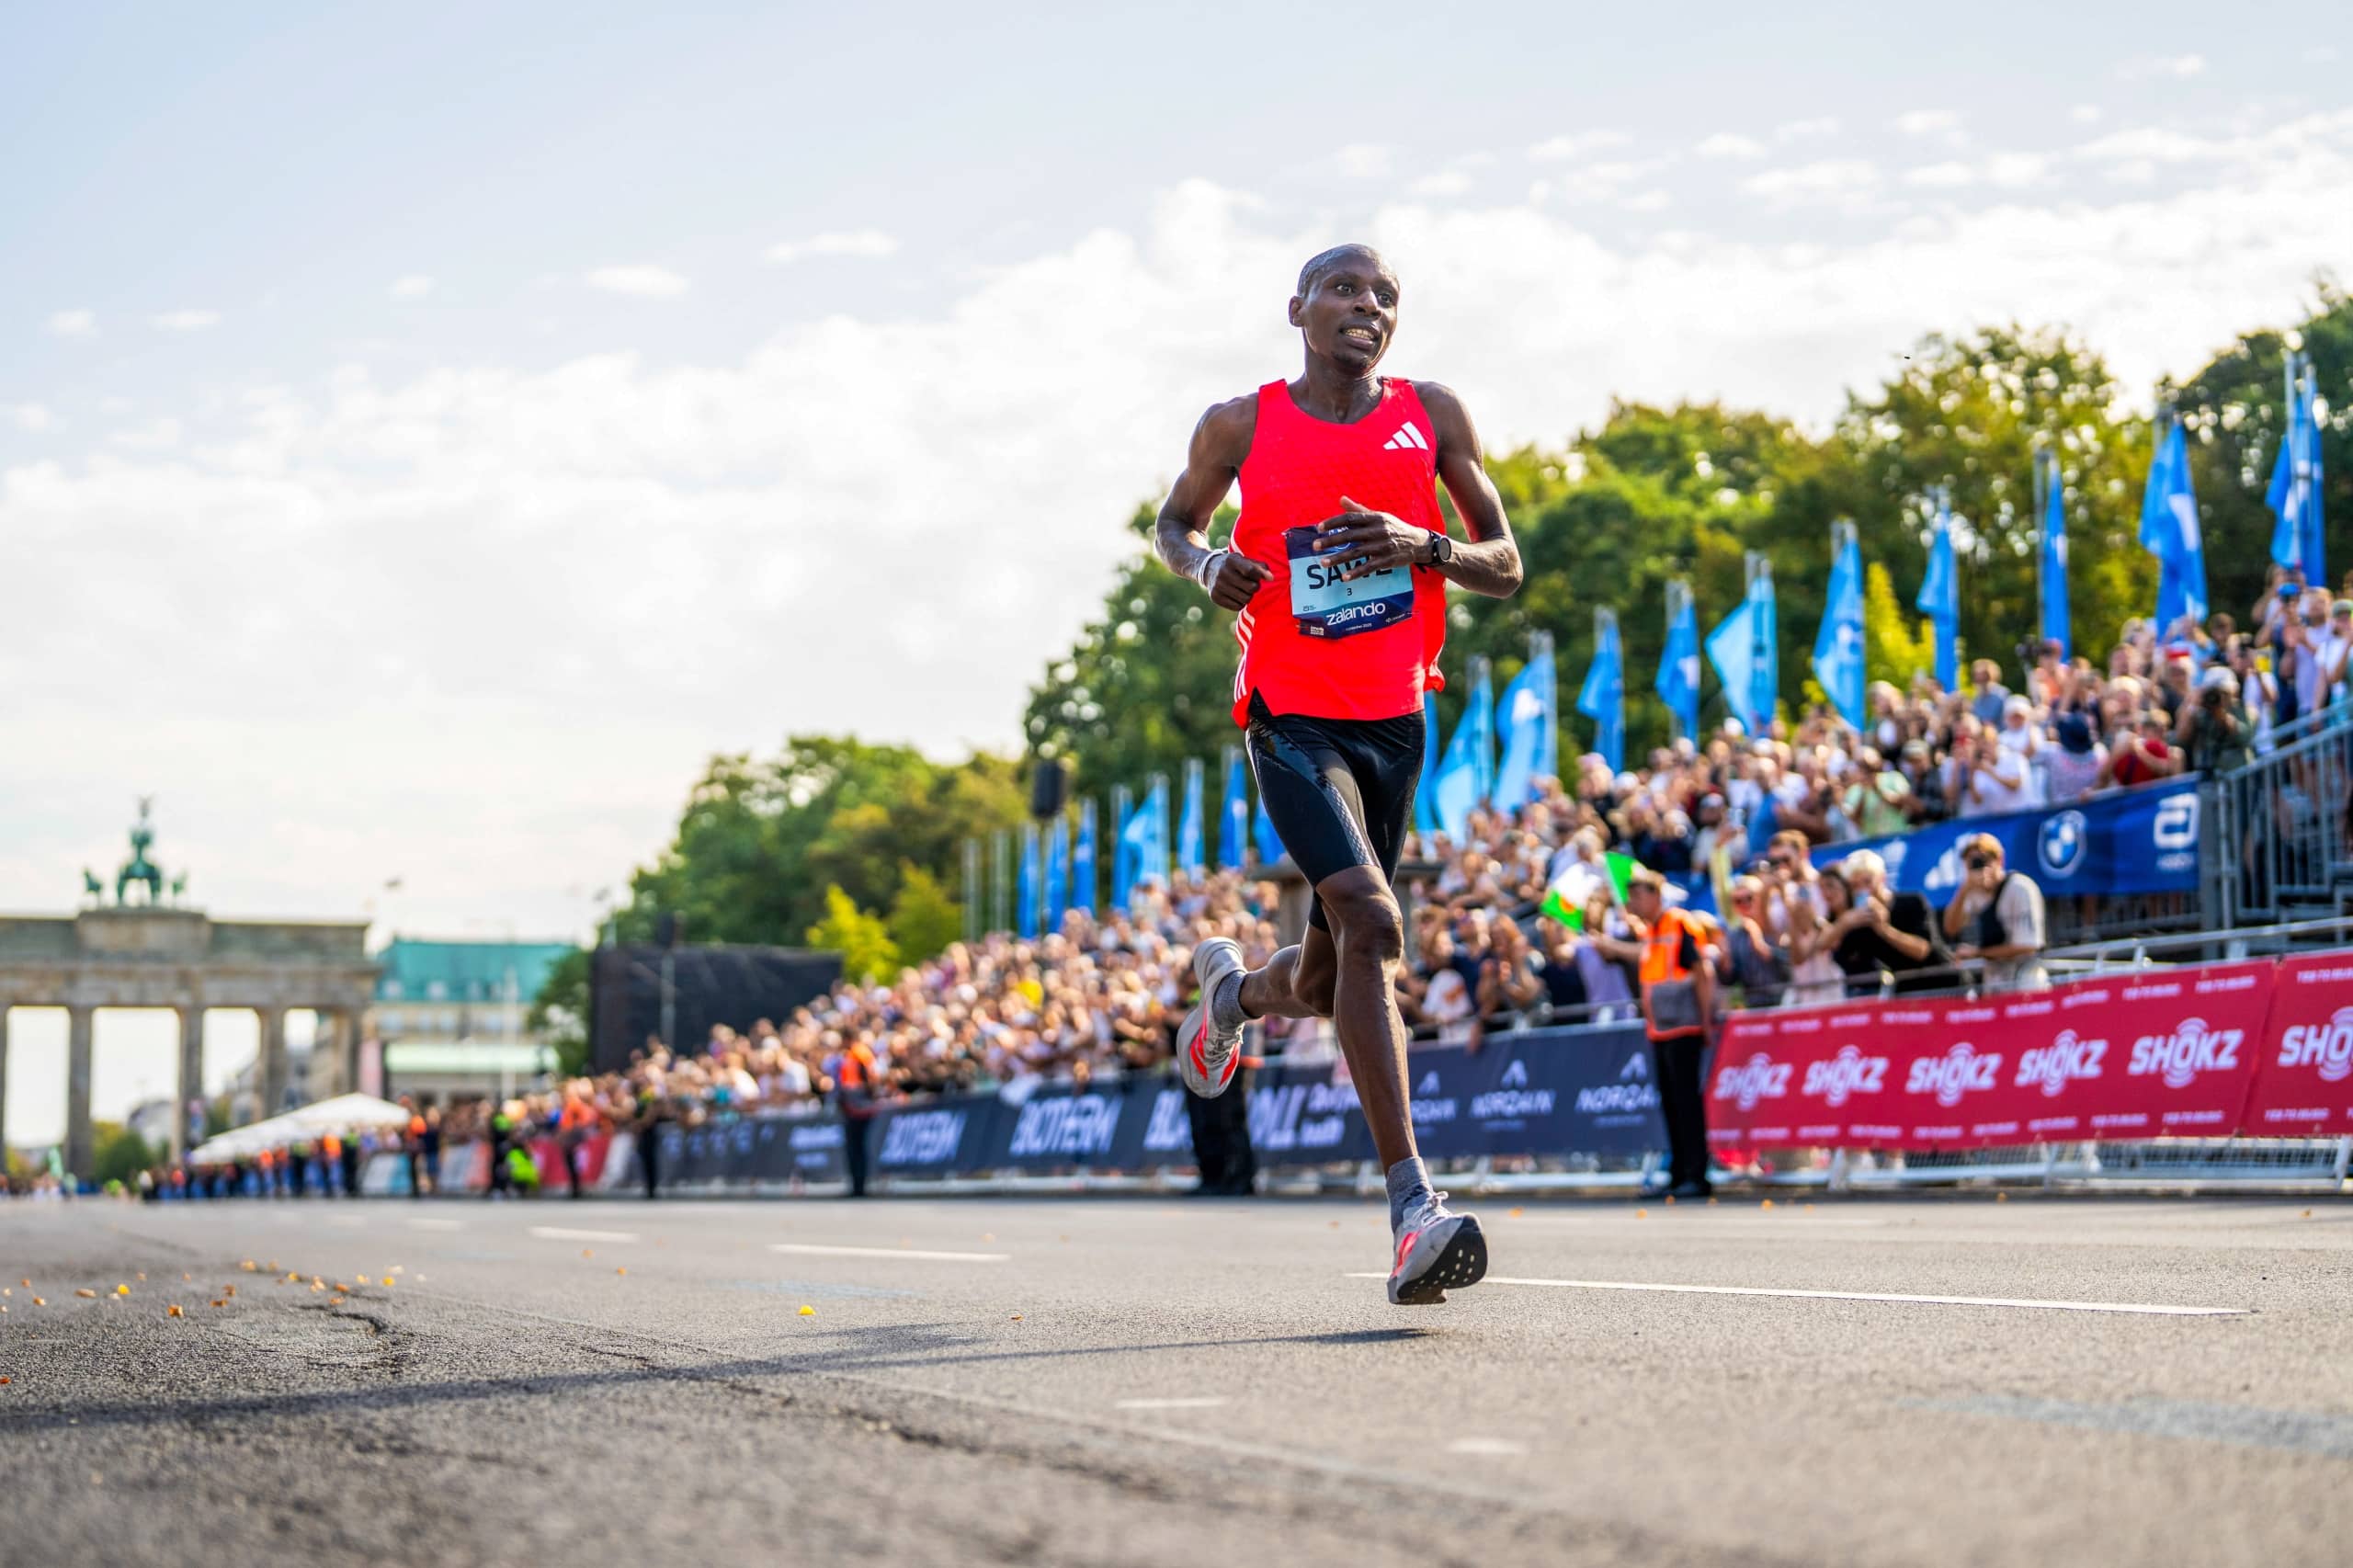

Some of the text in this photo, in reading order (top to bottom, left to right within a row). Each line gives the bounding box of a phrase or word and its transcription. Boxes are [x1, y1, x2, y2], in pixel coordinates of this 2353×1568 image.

[1346, 587, 1353, 597] 3
[1325, 601, 1386, 626] zalando
[2013, 1037, 2109, 1087] SHOKZ
[2126, 1027, 2245, 1077] SHOKZ
[2277, 1022, 2353, 1068] SHO
[1713, 1062, 1793, 1100] SHOKZ
[1801, 1055, 1890, 1096] SHOKZ
[1904, 1051, 2004, 1095] SHOKZ
